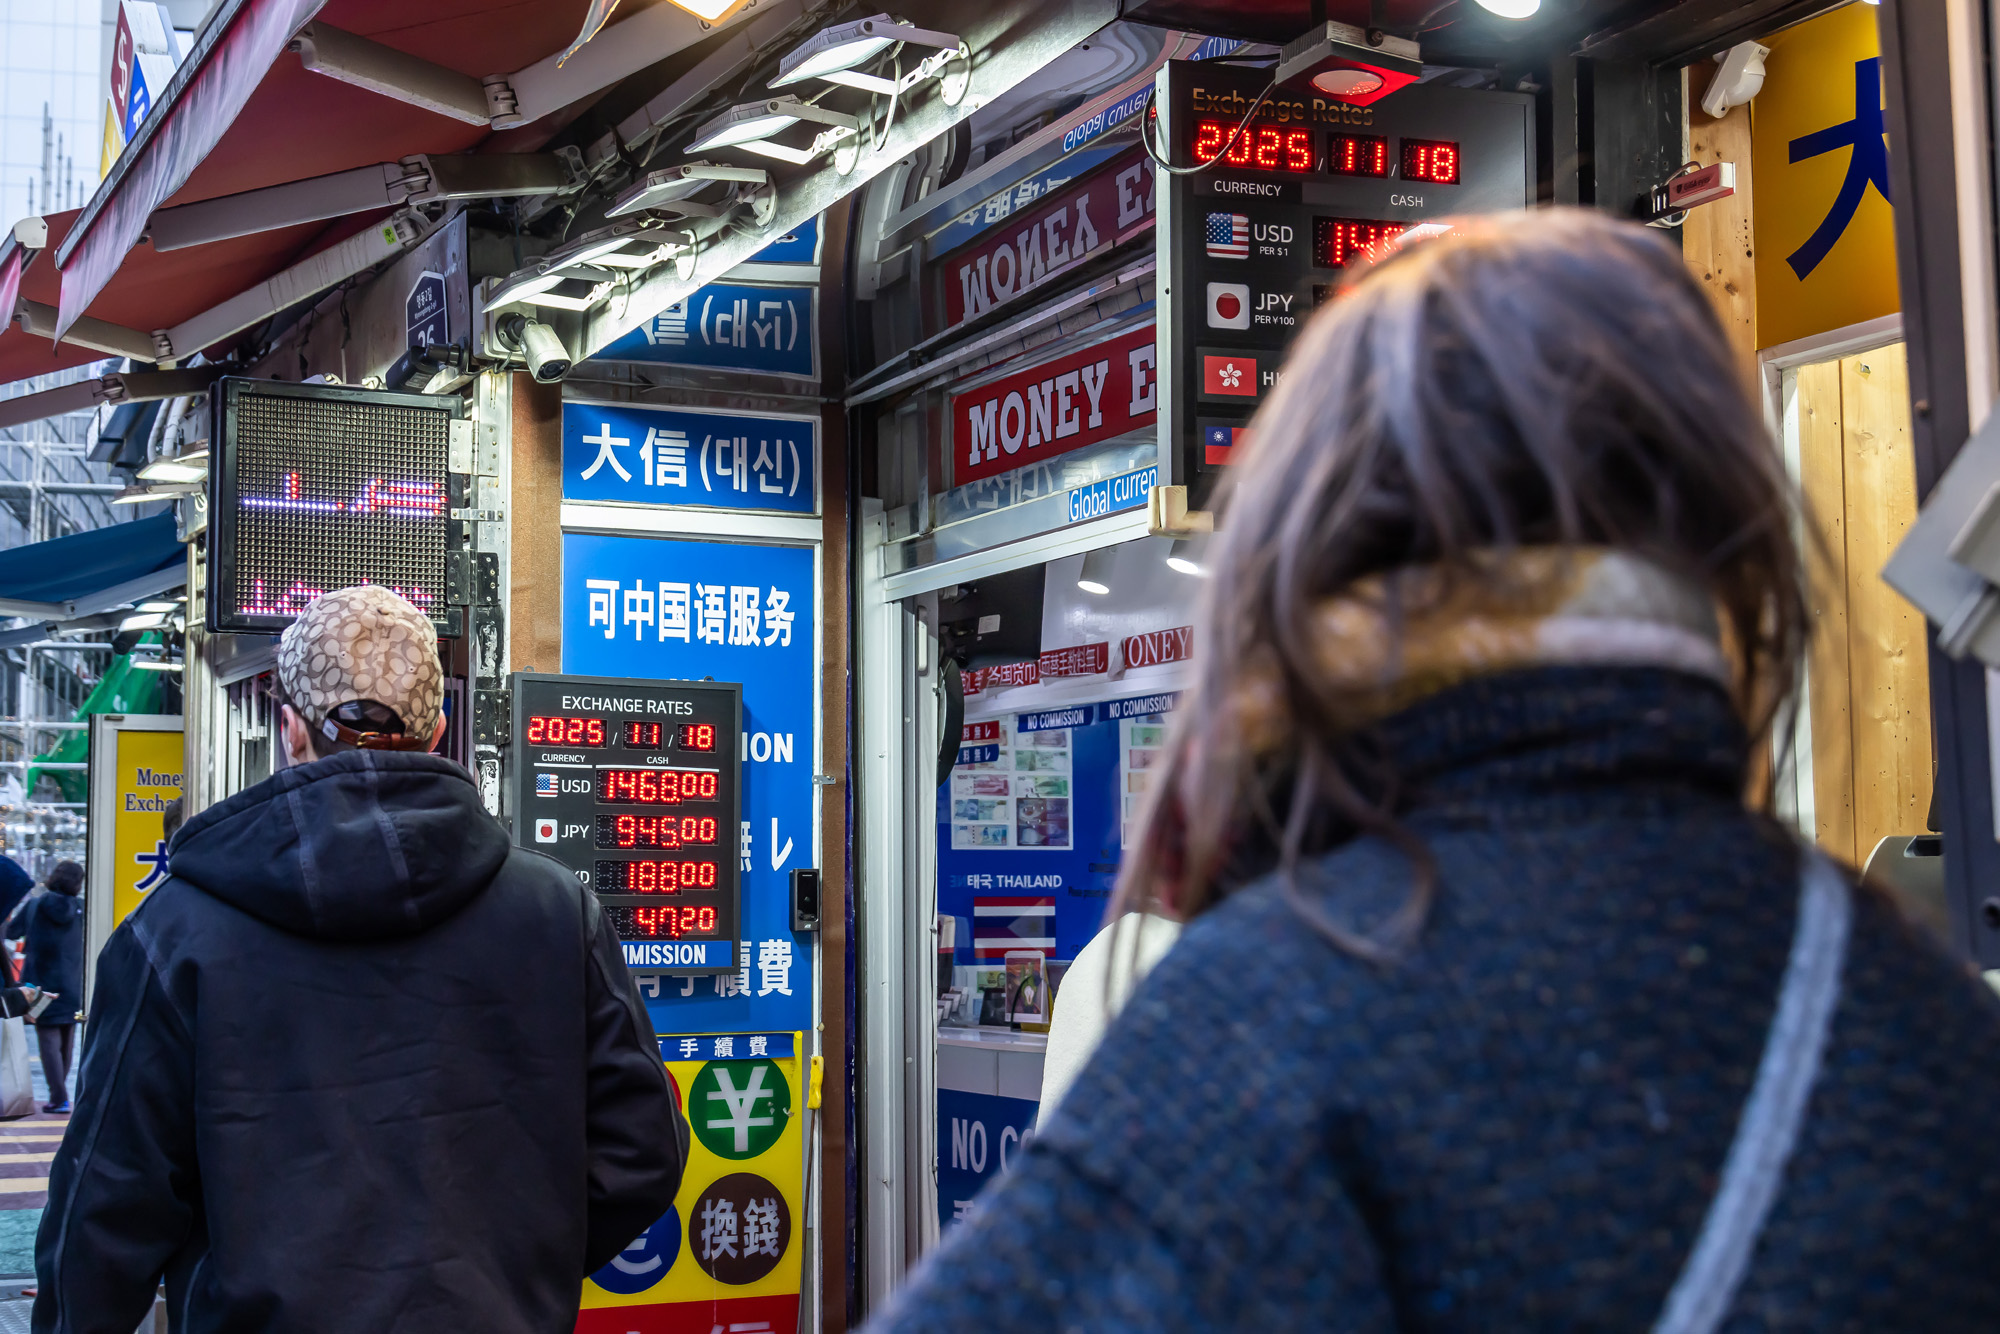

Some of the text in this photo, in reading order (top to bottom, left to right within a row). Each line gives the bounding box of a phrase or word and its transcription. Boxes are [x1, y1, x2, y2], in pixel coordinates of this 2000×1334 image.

[1192, 87, 1374, 126] Exchange Rates
[1197, 124, 1310, 169] 2025
[1347, 139, 1382, 172] 11
[1419, 146, 1453, 181] 18
[1213, 180, 1282, 197] CURRENCY
[1390, 194, 1424, 208] CASH
[1254, 224, 1293, 244] USD
[1259, 246, 1275, 256] PER
[1255, 292, 1293, 312] JPY
[1255, 314, 1271, 324] PER
[1263, 371, 1287, 386] HK
[968, 359, 1109, 466] MONEY
[1069, 468, 1157, 521] Global curren
[586, 578, 795, 647] 可中国语服务
[1128, 626, 1193, 667] ONEY
[562, 695, 693, 715] EXCHANGE RATES
[1109, 694, 1173, 718] NO COMMISSION
[1027, 709, 1084, 730] NO COMMISSION
[527, 717, 603, 744] 2025
[632, 722, 659, 744] 11
[688, 725, 713, 749] 18
[741, 732, 794, 763] ION
[541, 753, 586, 764] CURRENCY
[646, 756, 669, 765] CASH
[561, 778, 591, 794] USD
[124, 792, 175, 813] Exch
[561, 825, 589, 839] JPY
[967, 874, 993, 889] 태국
[996, 874, 1063, 888] THAILAND
[622, 944, 706, 965] MISSION
[952, 1117, 988, 1174] NO
[701, 1197, 782, 1260] 換錢
